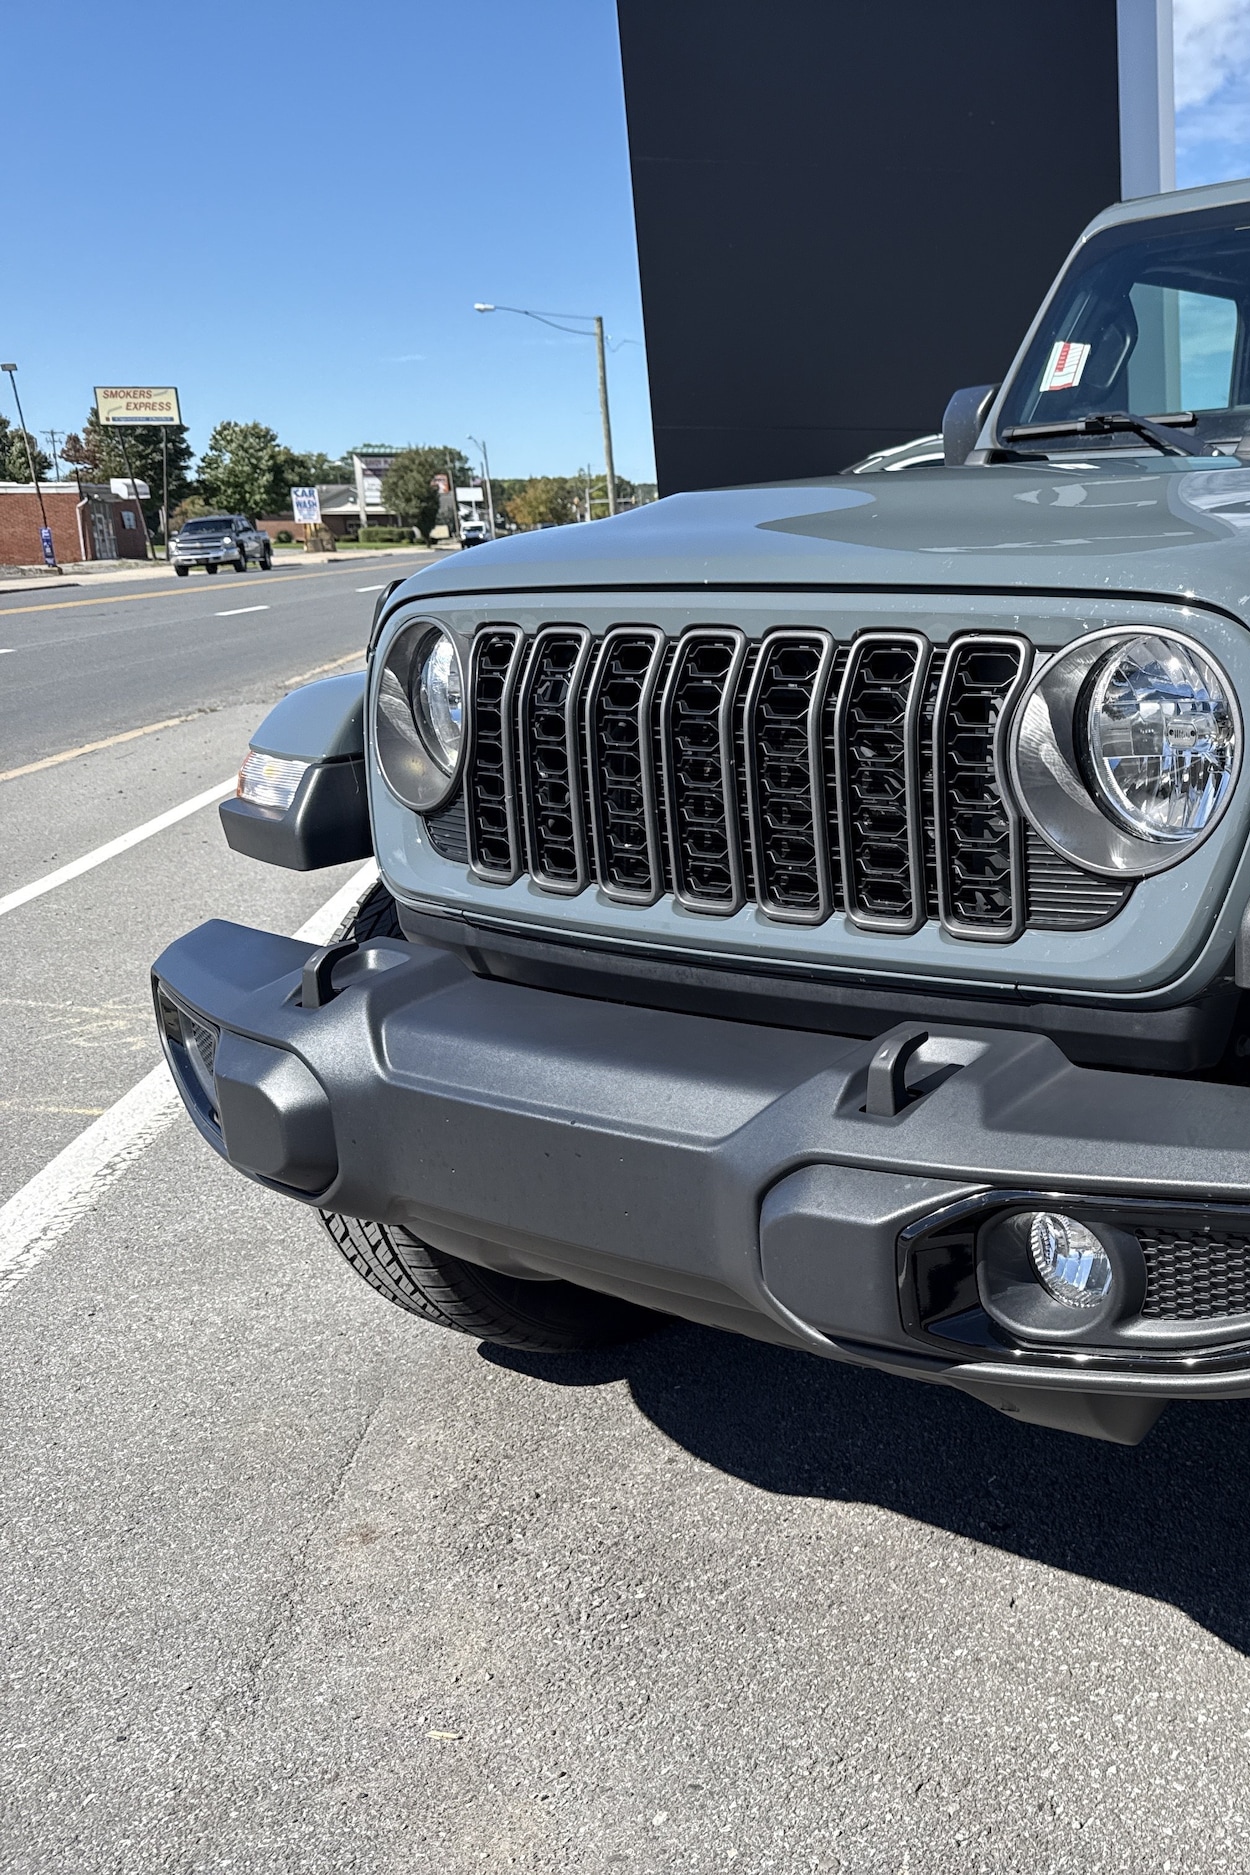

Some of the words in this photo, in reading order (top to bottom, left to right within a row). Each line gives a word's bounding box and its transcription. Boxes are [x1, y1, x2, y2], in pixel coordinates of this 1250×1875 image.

[103, 390, 152, 399] SMOKERS
[126, 402, 172, 411] EXPRESS
[294, 490, 315, 499] CAR
[296, 500, 317, 509] WASH
